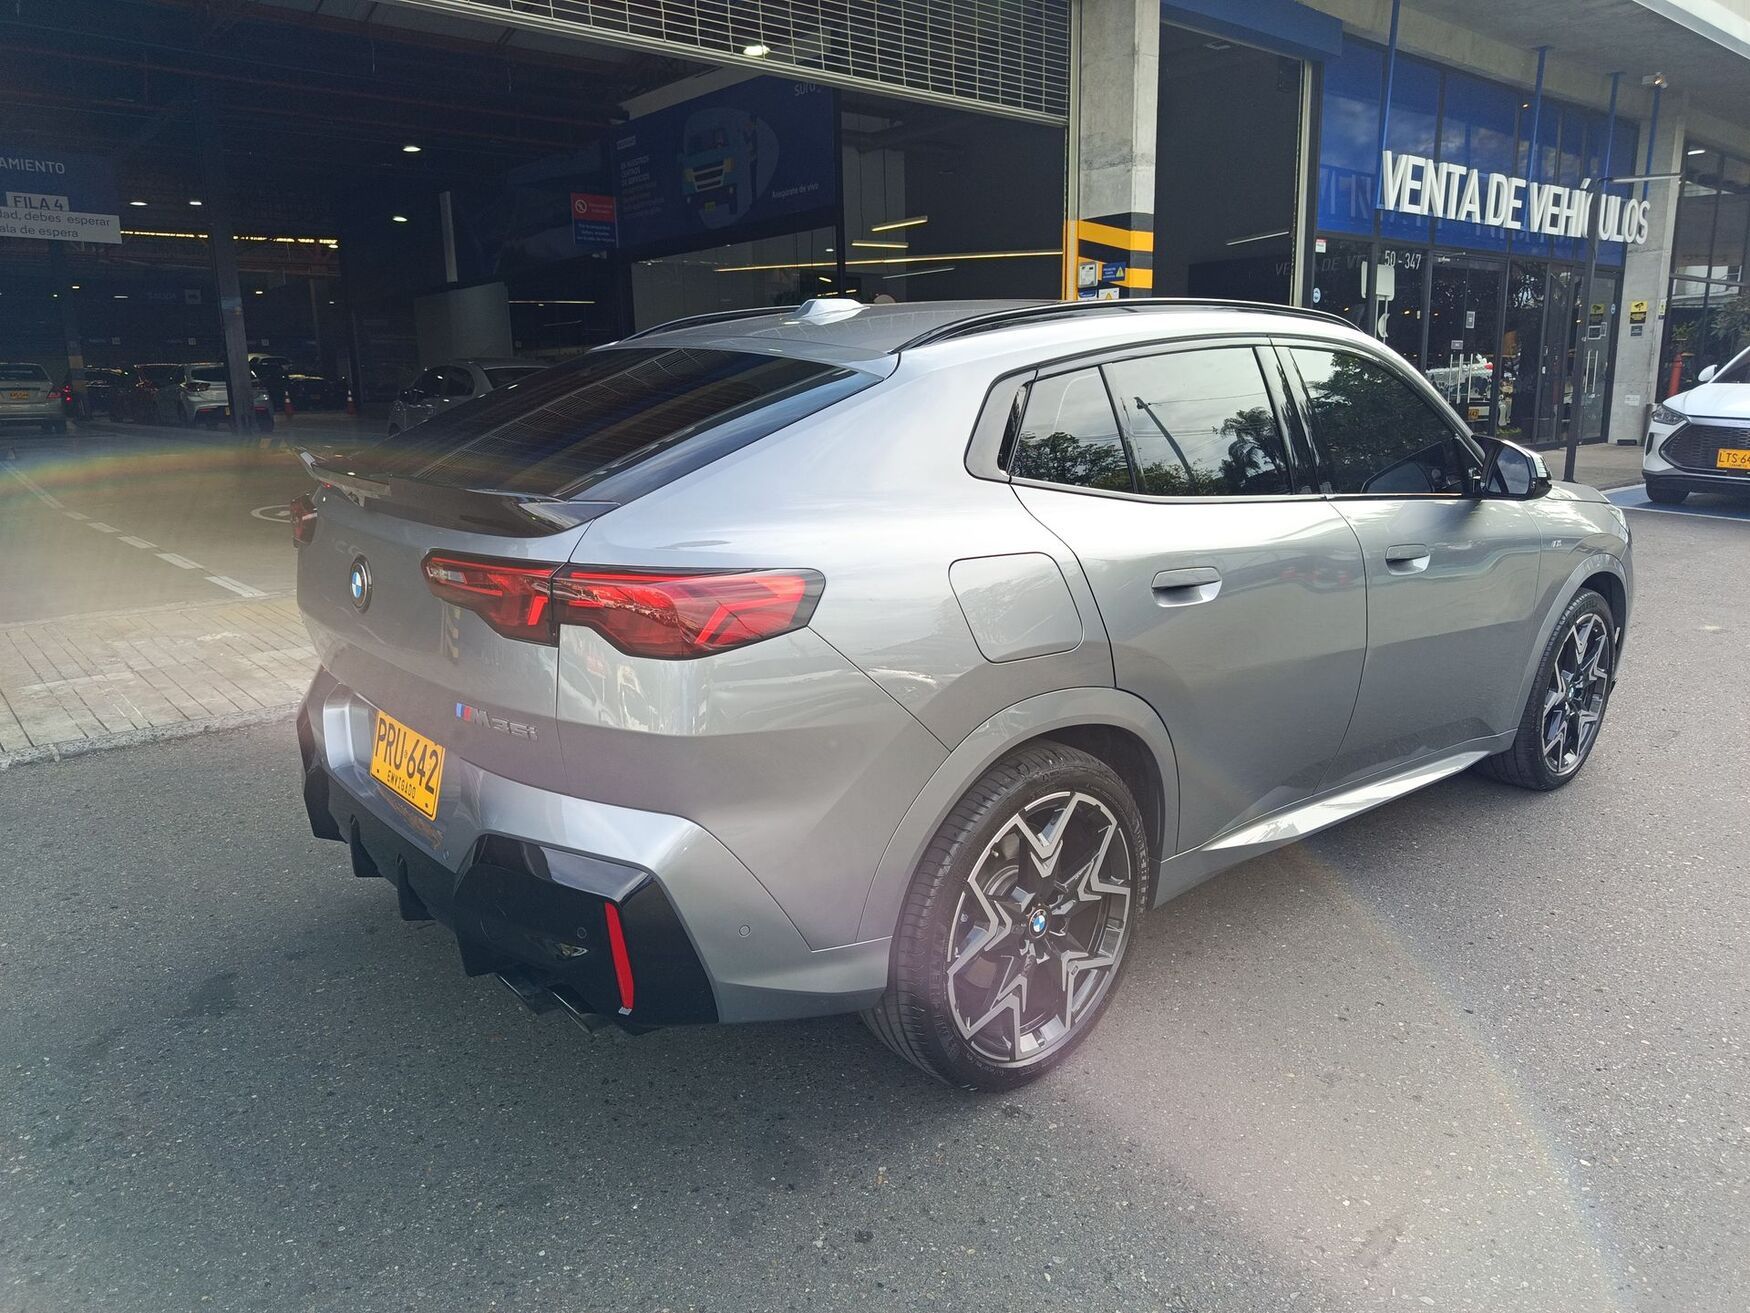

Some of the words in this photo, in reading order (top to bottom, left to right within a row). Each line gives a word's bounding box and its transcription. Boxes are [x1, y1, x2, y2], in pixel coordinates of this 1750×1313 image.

[0, 157, 65, 174] AMIENTO
[1382, 150, 1481, 224] VENTA
[1485, 172, 1527, 229] DE
[13, 195, 50, 210] FILA
[54, 199, 63, 211] 4
[24, 212, 62, 223] debes
[66, 216, 110, 227] esperar
[20, 226, 36, 235] de
[38, 228, 79, 239] espera
[1384, 250, 1396, 267] 50
[1404, 253, 1422, 271] 347
[1719, 452, 1738, 463] LTS
[375, 717, 406, 770] PRU
[406, 739, 439, 794] 642
[387, 770, 416, 799] ENVIGADO
